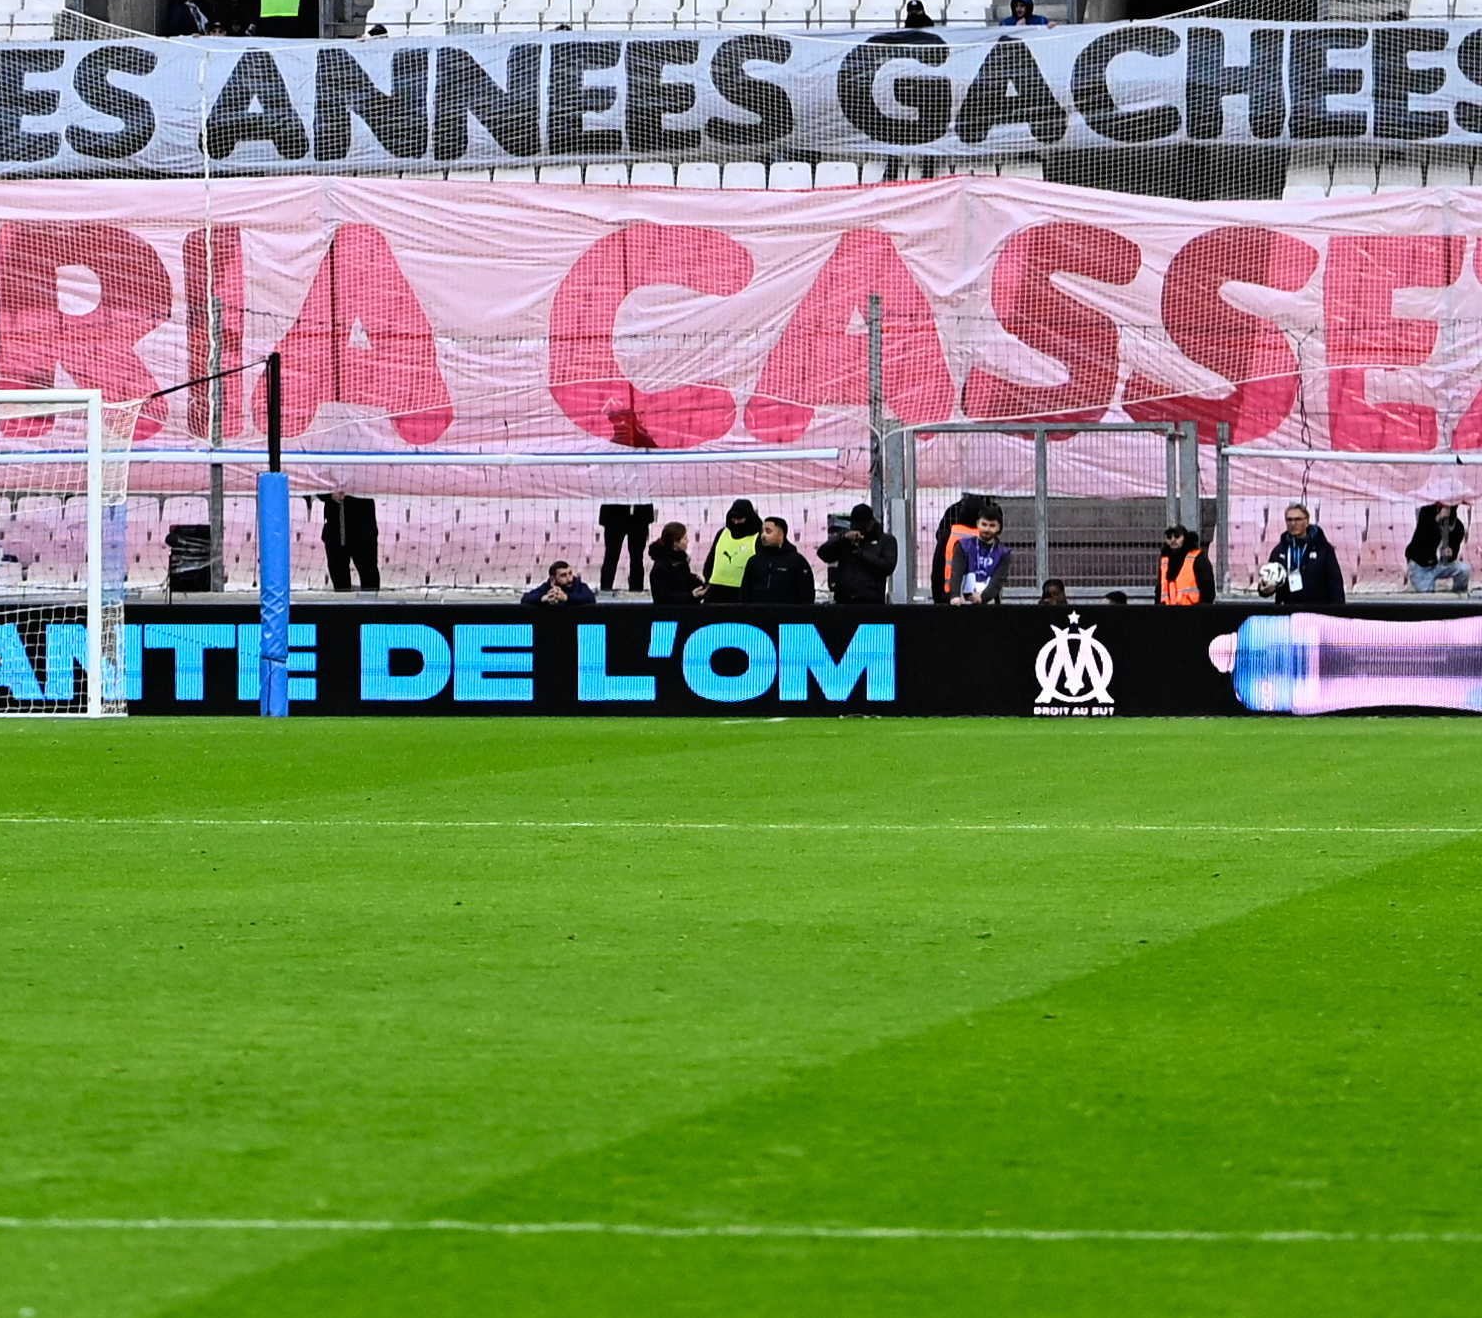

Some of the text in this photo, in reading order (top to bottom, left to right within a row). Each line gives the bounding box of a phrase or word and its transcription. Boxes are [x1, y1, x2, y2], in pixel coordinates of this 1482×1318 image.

[201, 35, 796, 162] ANNEES
[360, 623, 533, 702] DE
[578, 621, 895, 702] L'OM
[1034, 707, 1114, 716] DROIT AU BUT
